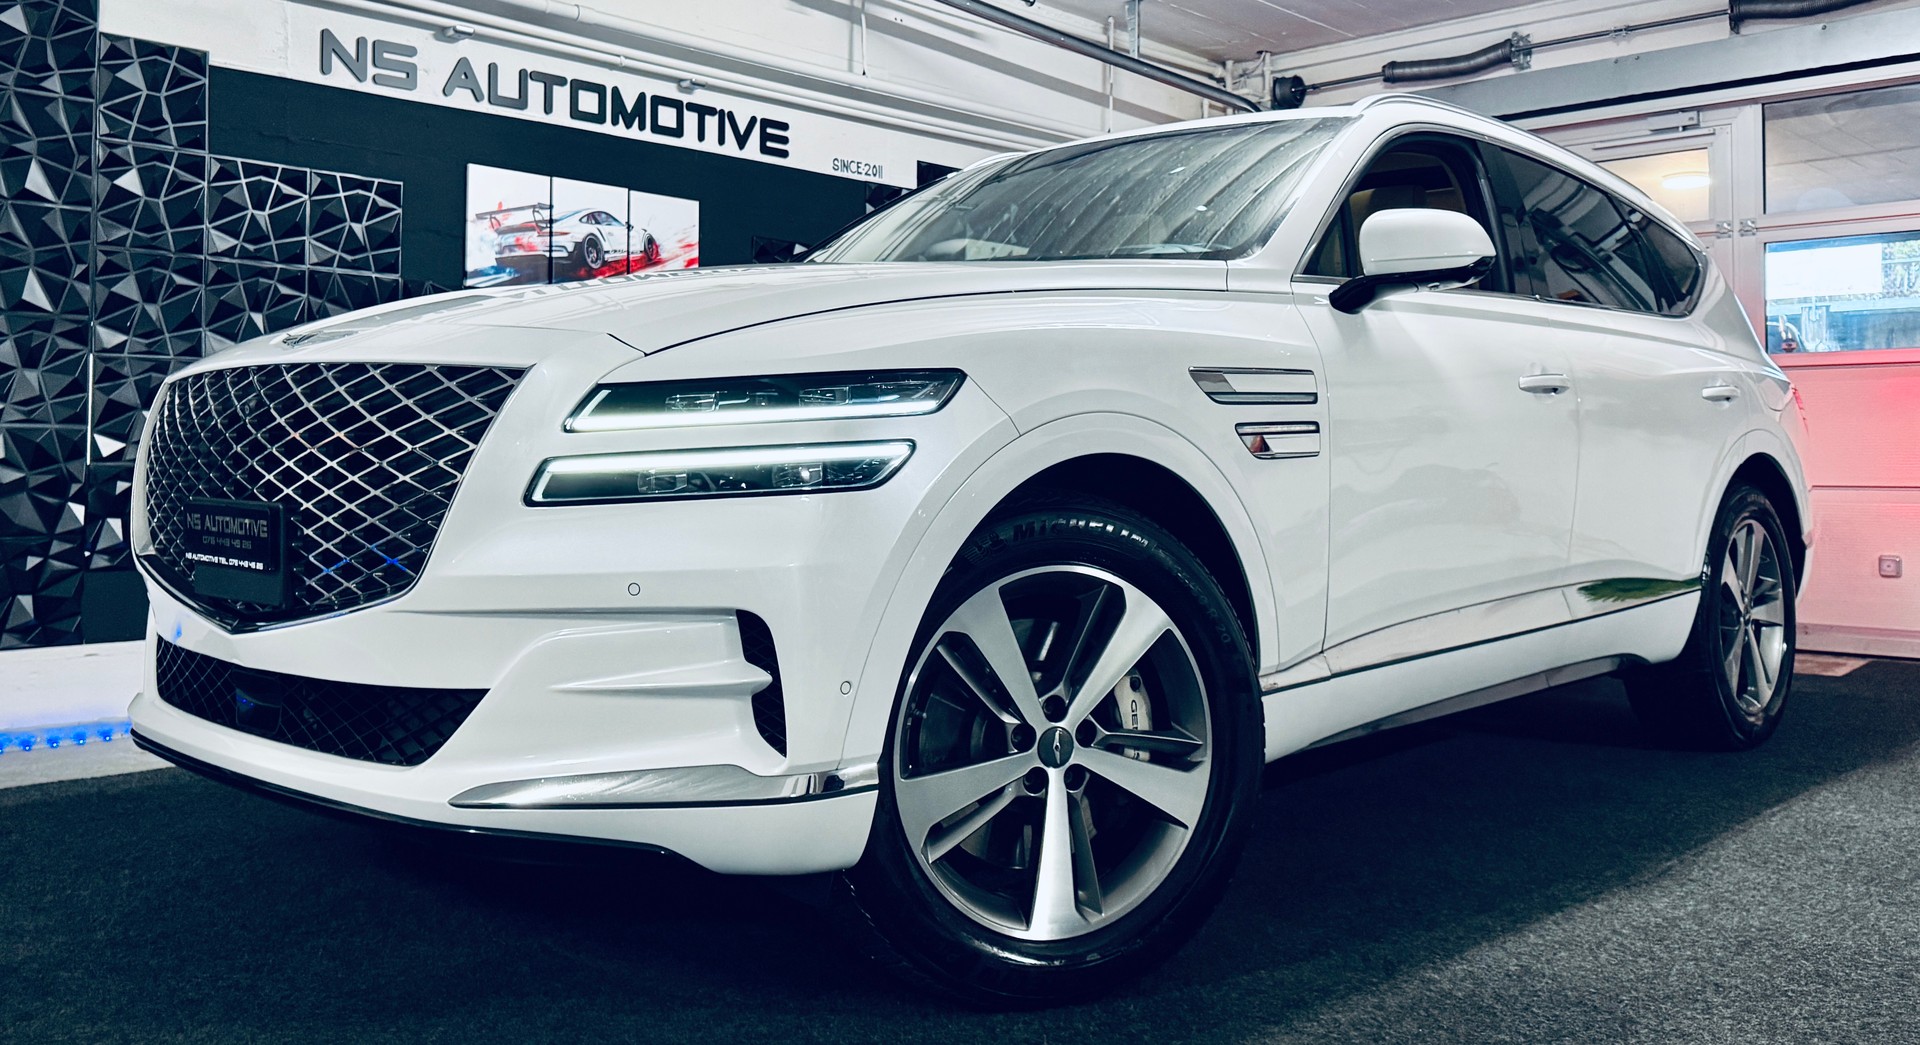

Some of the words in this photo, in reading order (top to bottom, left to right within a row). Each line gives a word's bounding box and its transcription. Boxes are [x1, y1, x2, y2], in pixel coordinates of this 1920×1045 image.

[320, 28, 418, 91] NS
[443, 56, 790, 159] AUTOMOTIVE
[187, 513, 201, 530] NS
[204, 514, 268, 538] AUTOMOTIVE
